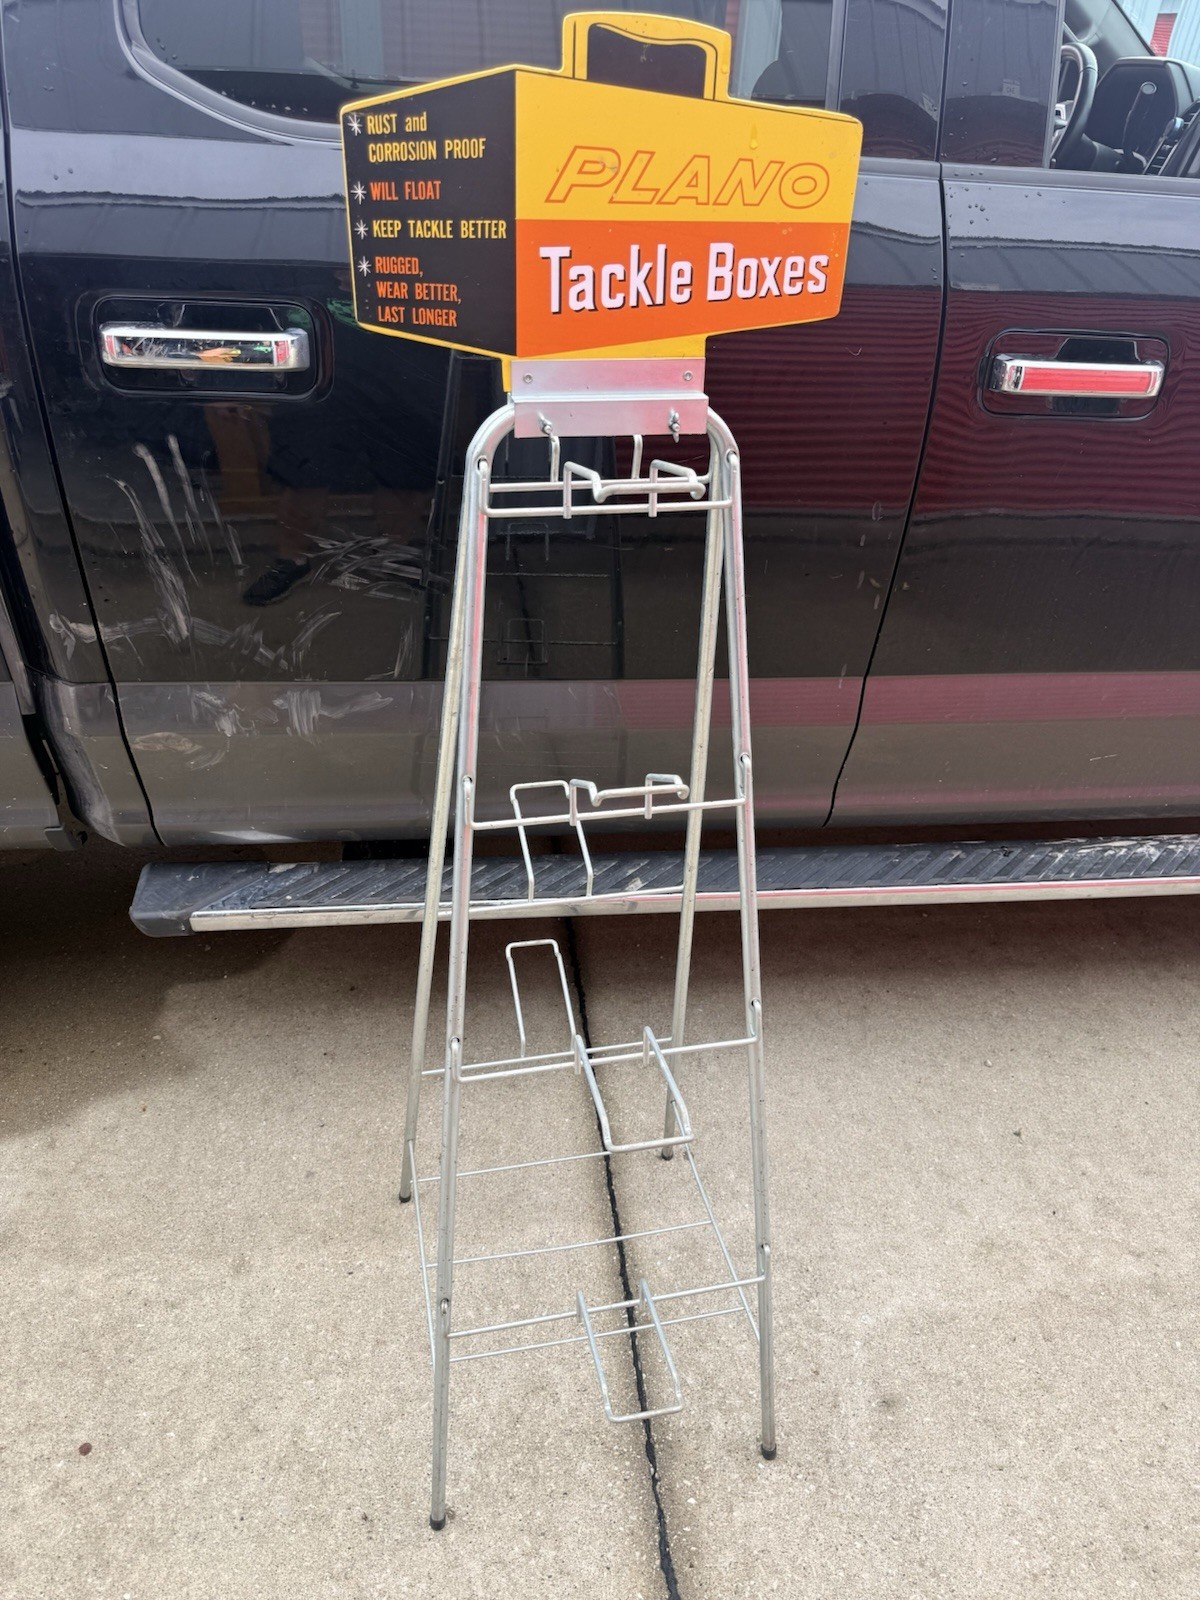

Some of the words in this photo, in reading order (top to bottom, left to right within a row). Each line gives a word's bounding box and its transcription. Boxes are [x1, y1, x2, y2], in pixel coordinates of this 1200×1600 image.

[366, 114, 397, 135] RUST
[405, 112, 427, 132] and
[368, 140, 437, 163] CORROSION
[445, 138, 486, 159] PROOF
[545, 145, 830, 209] PLANO
[370, 182, 398, 201] WILL
[405, 181, 441, 200] FLOAT
[373, 220, 401, 238] KEEP
[408, 220, 453, 238] TACKLE
[461, 220, 507, 239] BETTER
[375, 256, 424, 277] RUGGED,
[539, 244, 694, 314] Tackle
[707, 242, 830, 302] Boxes
[376, 281, 408, 299] WEAR
[415, 283, 462, 304] BETTER,
[378, 305, 405, 323] LAST
[413, 307, 457, 327] LONGER
